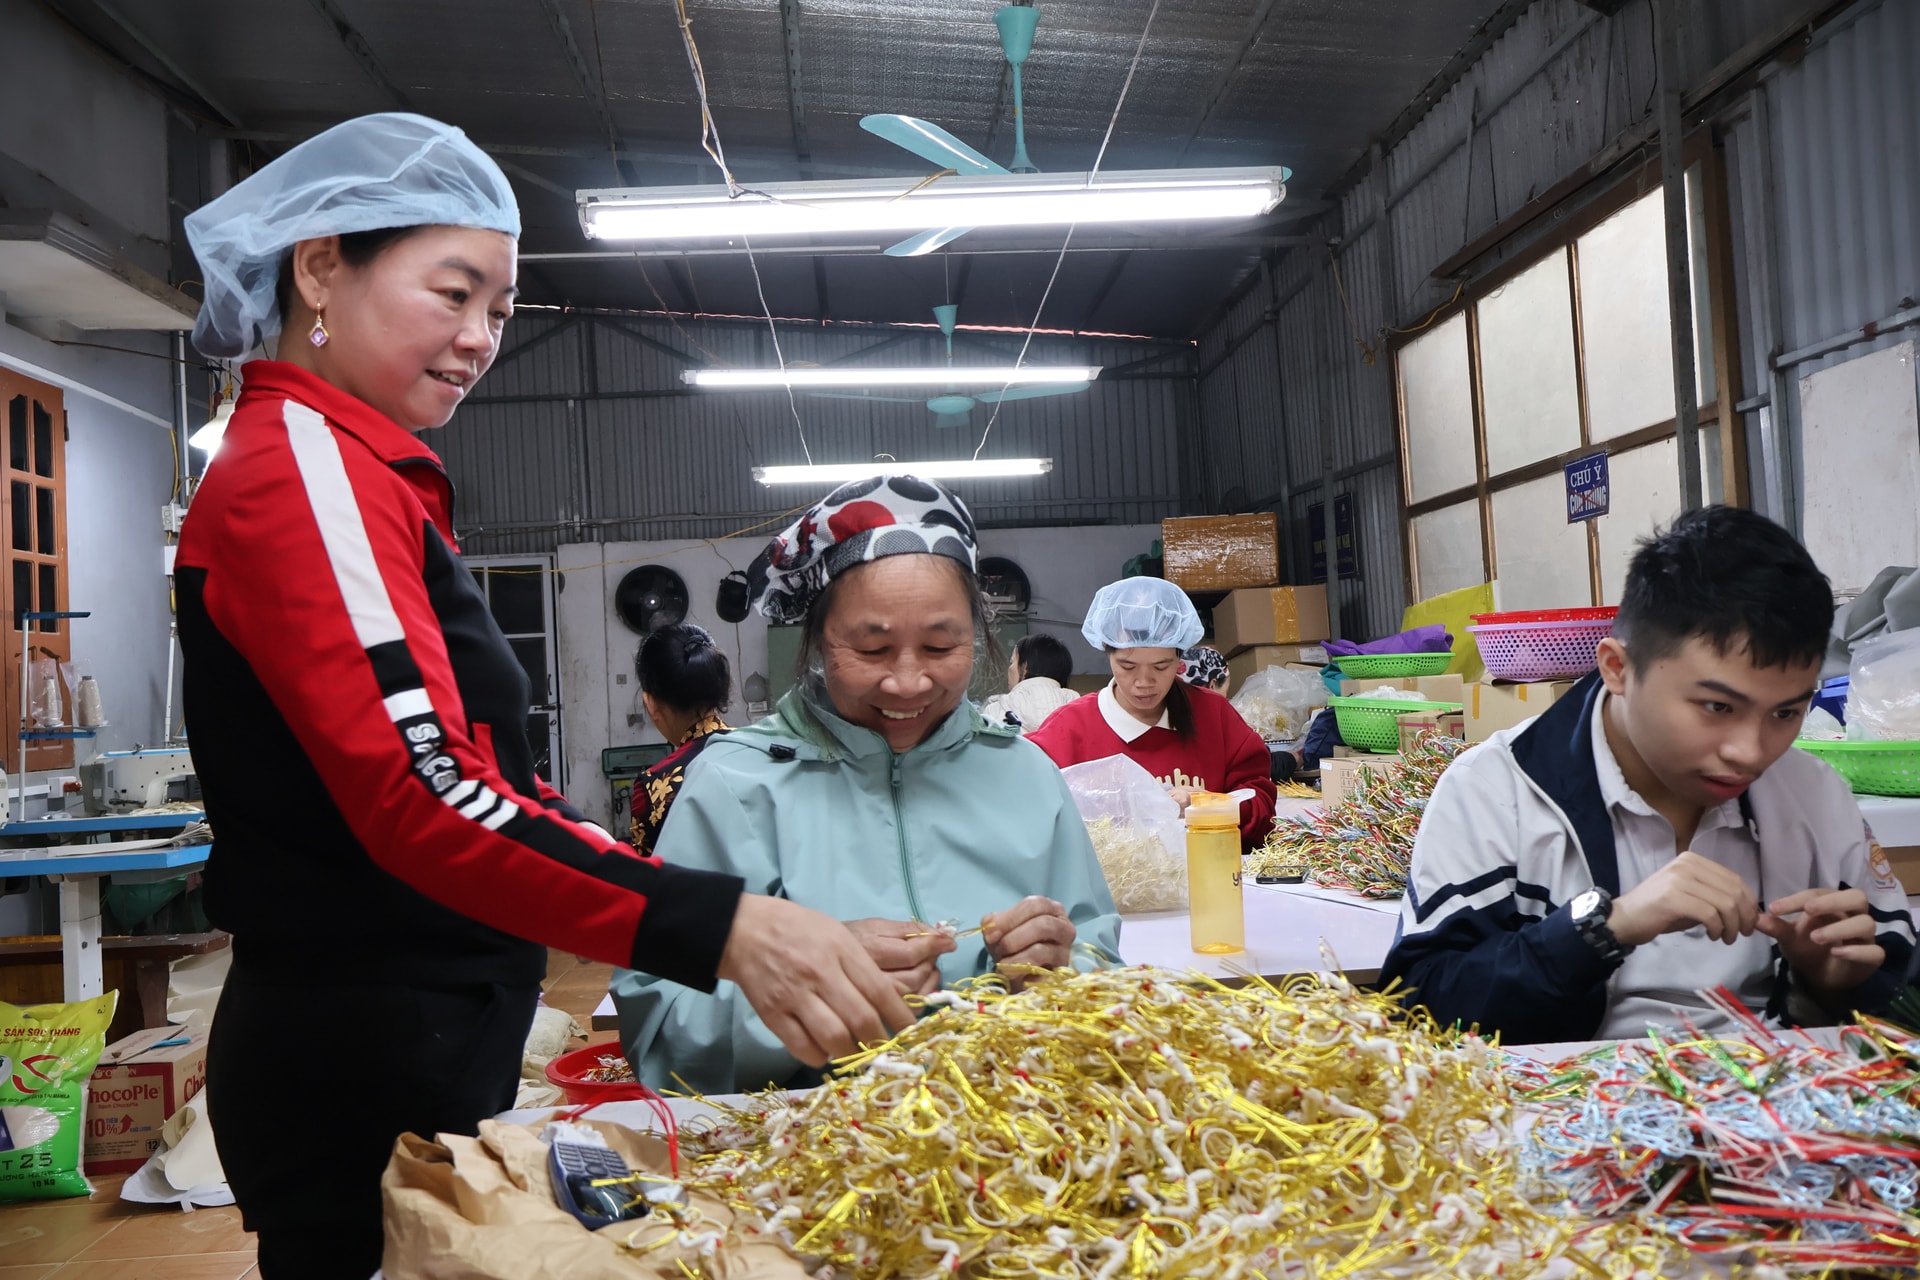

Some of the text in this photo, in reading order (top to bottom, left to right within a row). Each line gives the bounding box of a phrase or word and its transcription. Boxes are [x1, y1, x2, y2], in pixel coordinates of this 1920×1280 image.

[1570, 460, 1602, 488] CHÚ Ý
[87, 1084, 159, 1103] hocoPie
